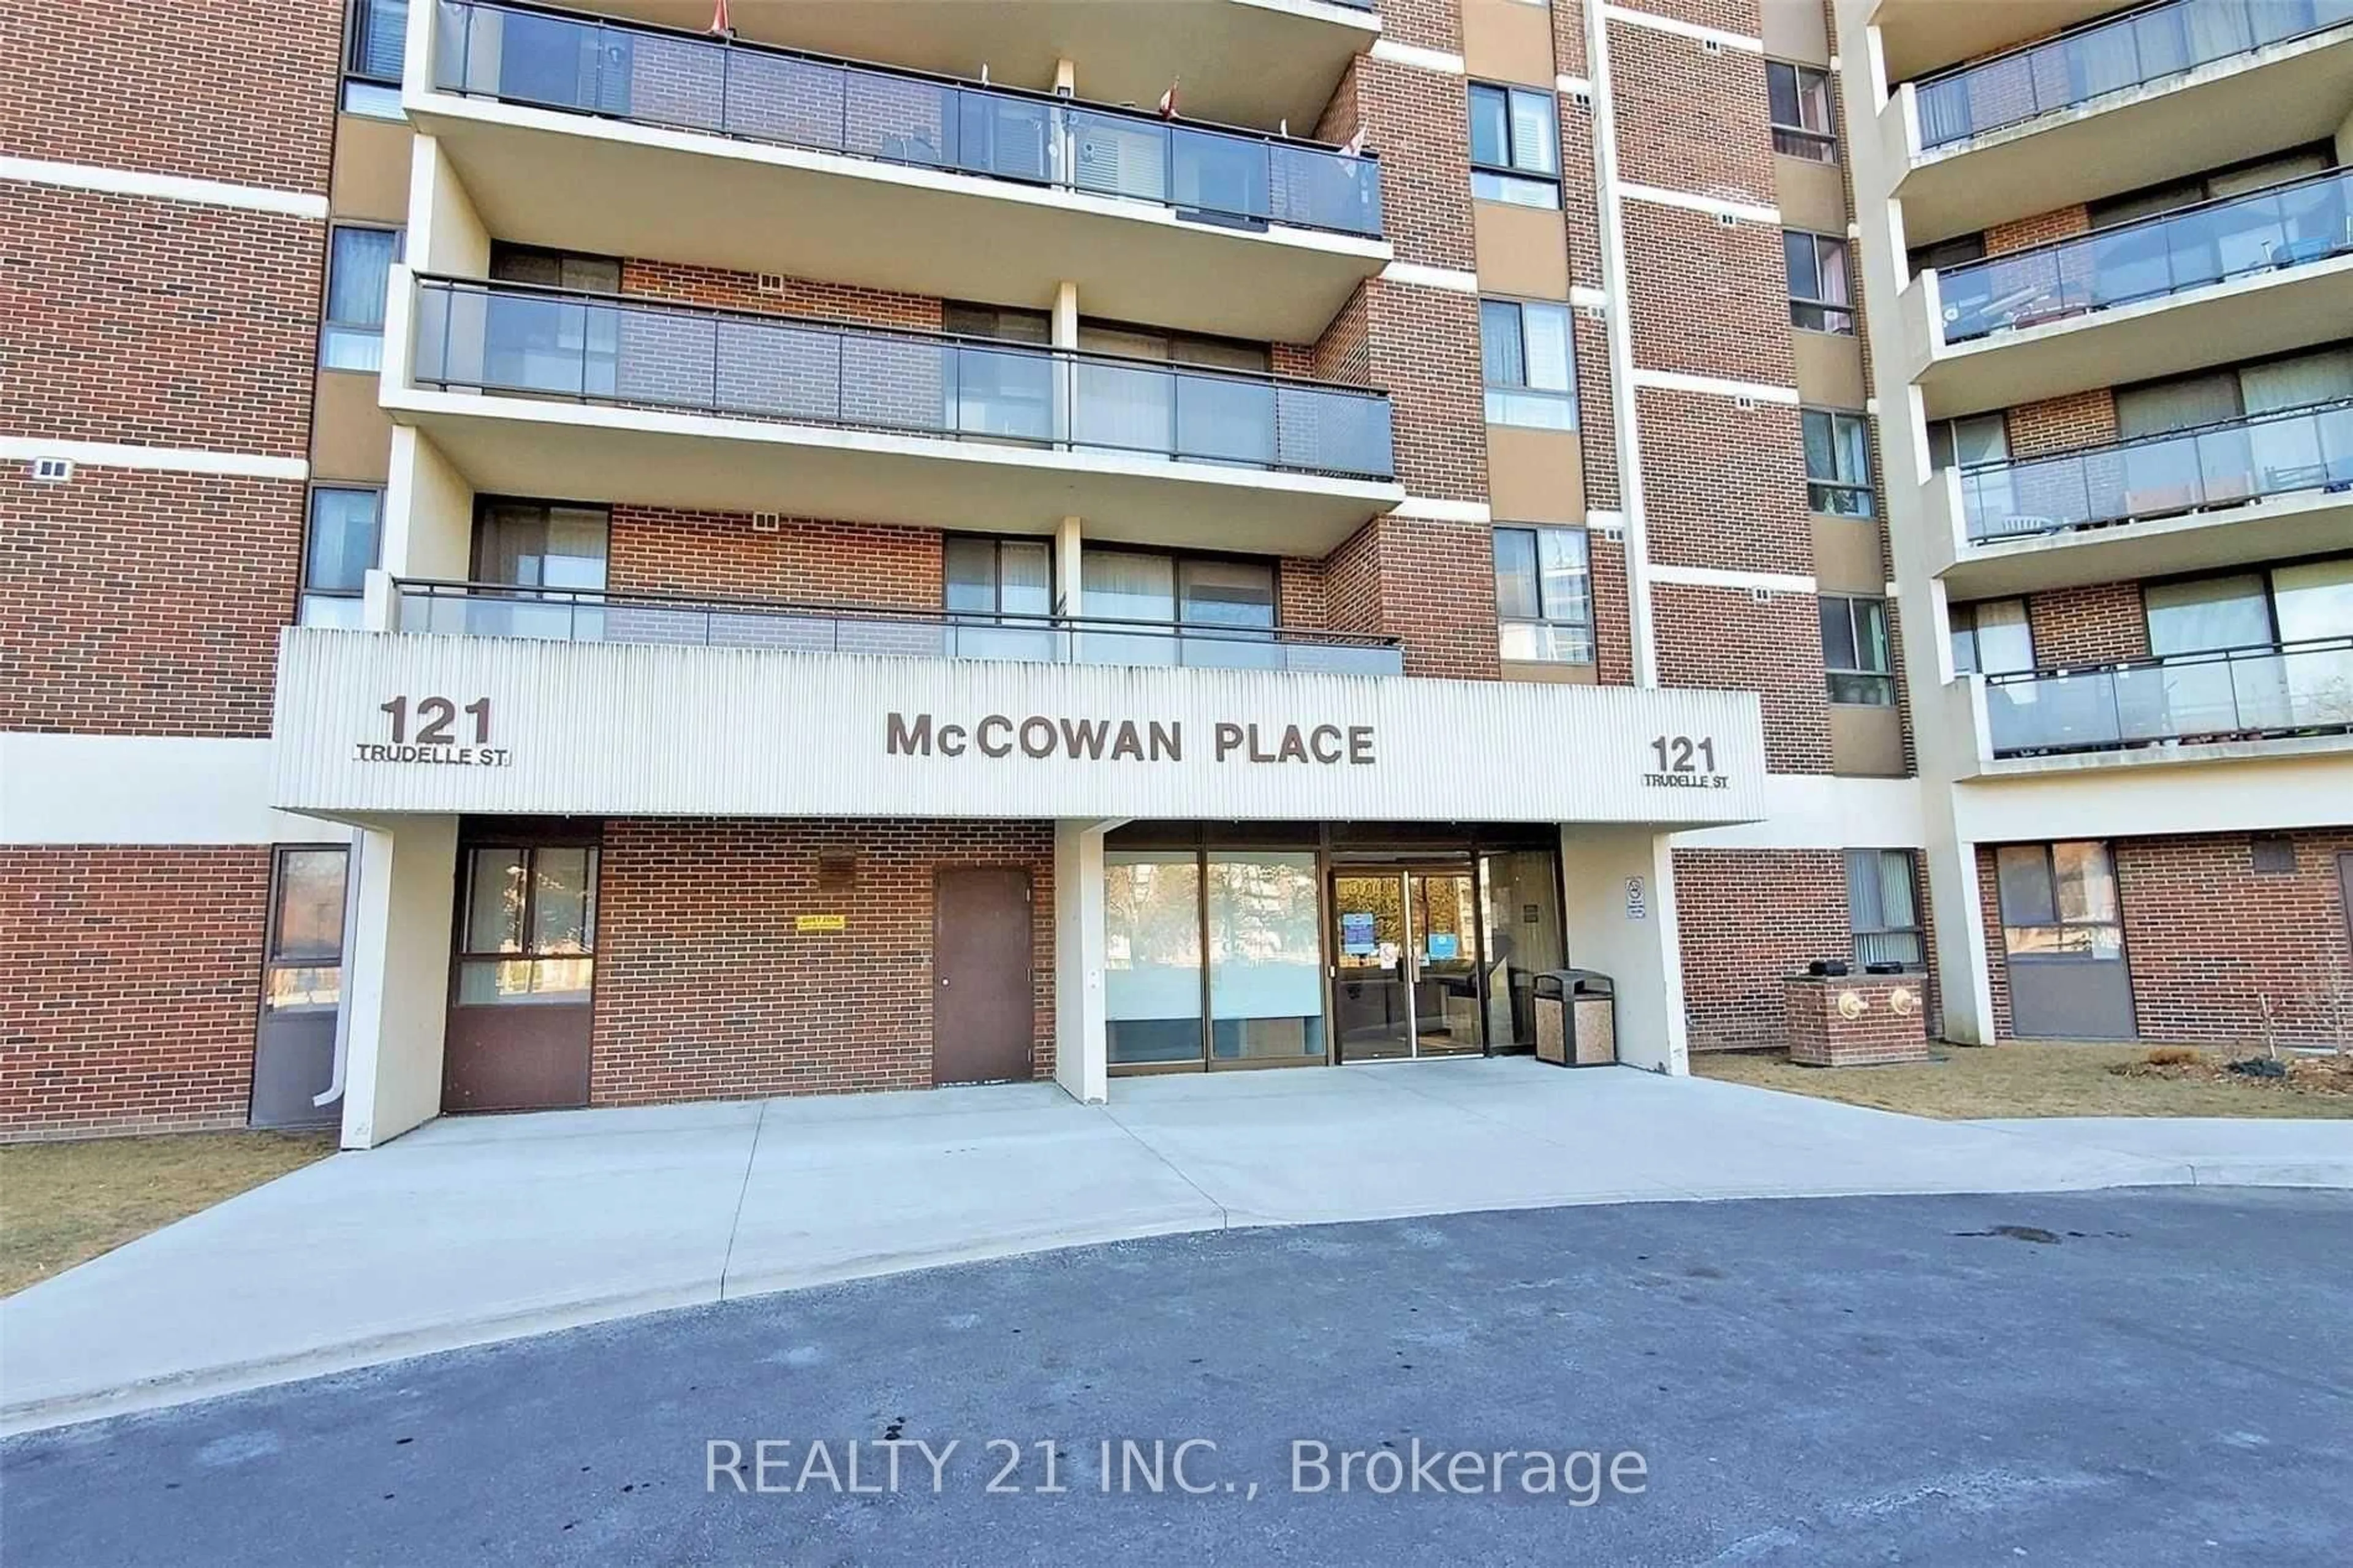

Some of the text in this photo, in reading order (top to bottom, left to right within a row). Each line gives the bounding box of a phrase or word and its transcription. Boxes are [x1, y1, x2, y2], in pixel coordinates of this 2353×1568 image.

[381, 695, 490, 744] 121
[356, 744, 472, 765] TRUDELLE
[886, 712, 1376, 764] McCOWAN PLACE
[1651, 736, 1715, 772] 121
[1644, 773, 1709, 788] TRUDELLE
